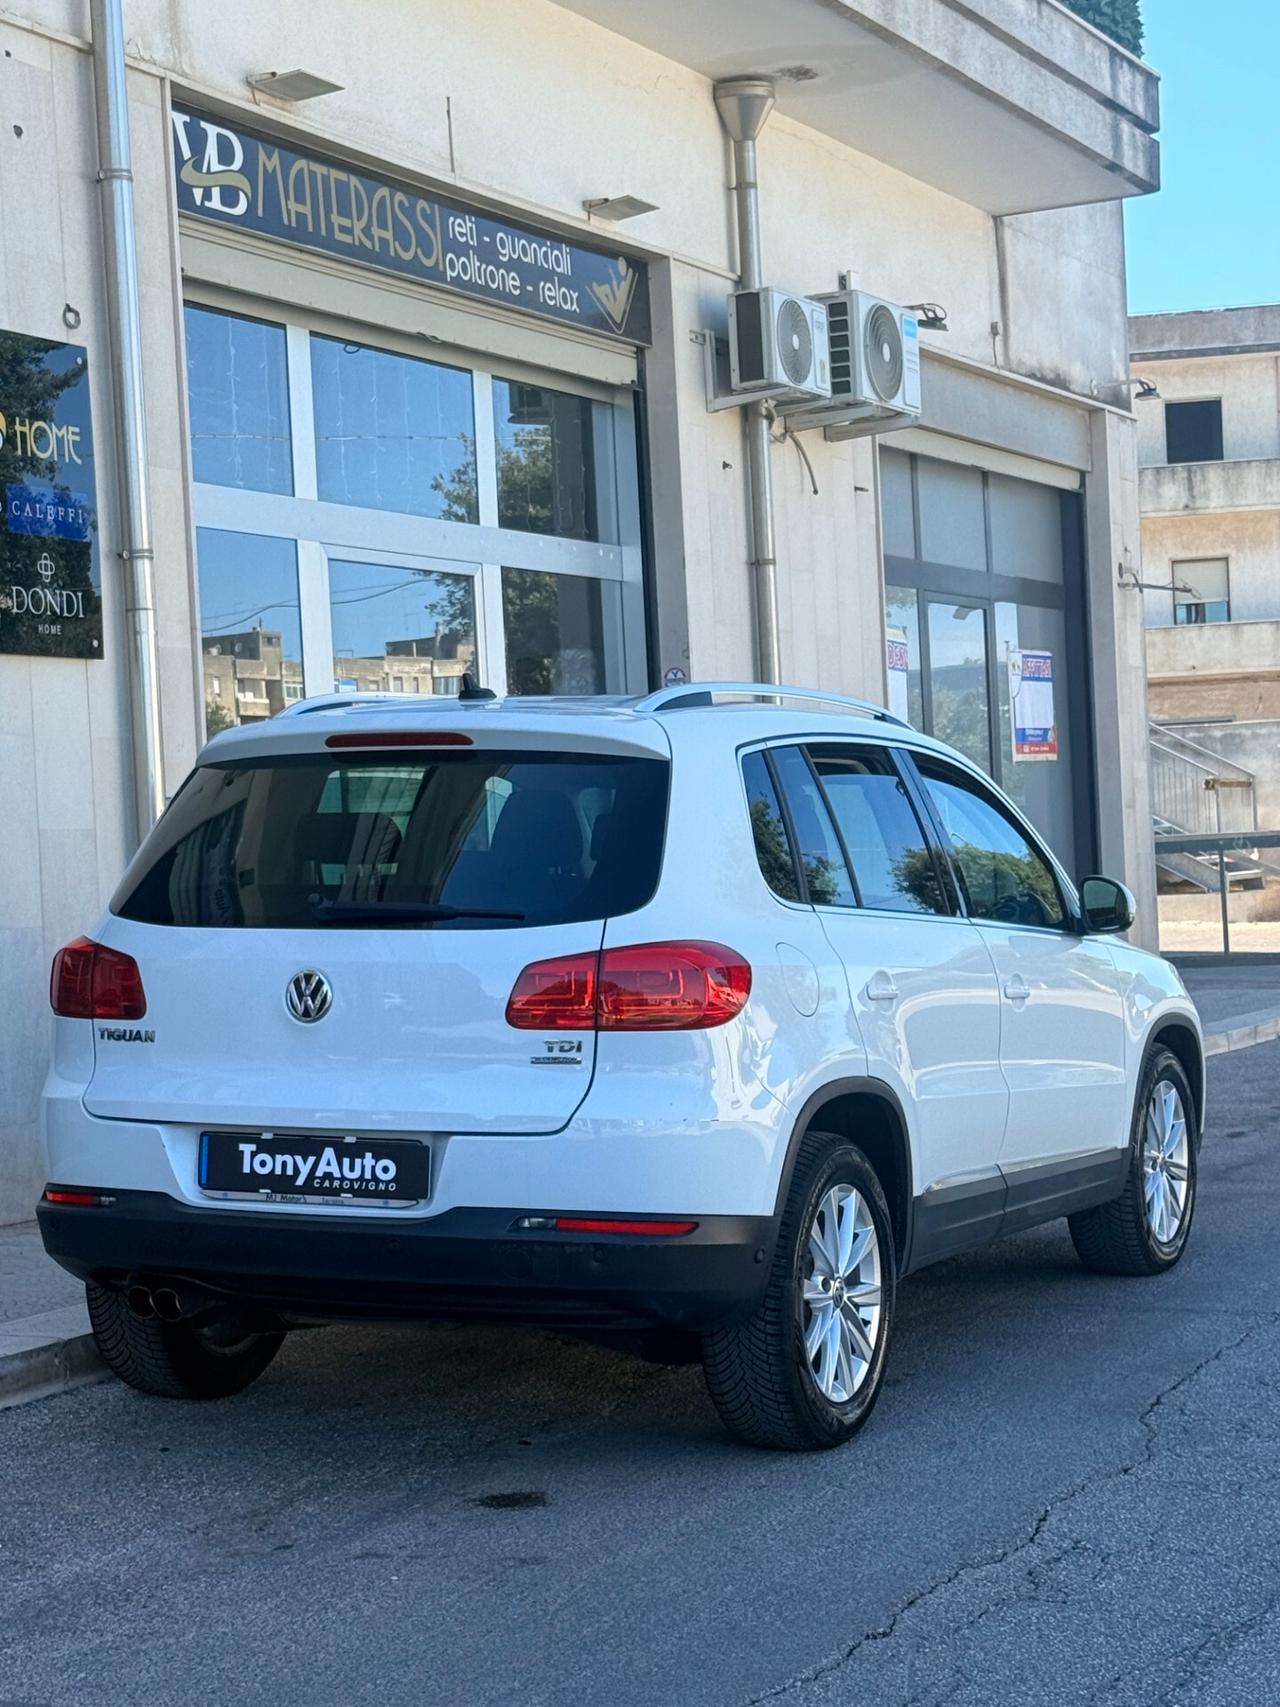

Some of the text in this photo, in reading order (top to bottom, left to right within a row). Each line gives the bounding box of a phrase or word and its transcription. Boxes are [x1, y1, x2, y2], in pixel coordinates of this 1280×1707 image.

[257, 142, 444, 272] MATERASSI
[448, 215, 477, 247] reti
[496, 231, 572, 277] guanciali
[446, 250, 521, 296] poltrone
[539, 277, 580, 313] relax
[14, 416, 82, 465] HOME
[12, 500, 83, 523] CALEFFI
[11, 585, 85, 618] DONDI
[38, 623, 62, 635] HOME
[98, 1026, 155, 1043] TIGUAN
[544, 1040, 582, 1053] TDI
[238, 1143, 397, 1186] TonyAuto
[313, 1178, 397, 1192] CAROVIGNO
